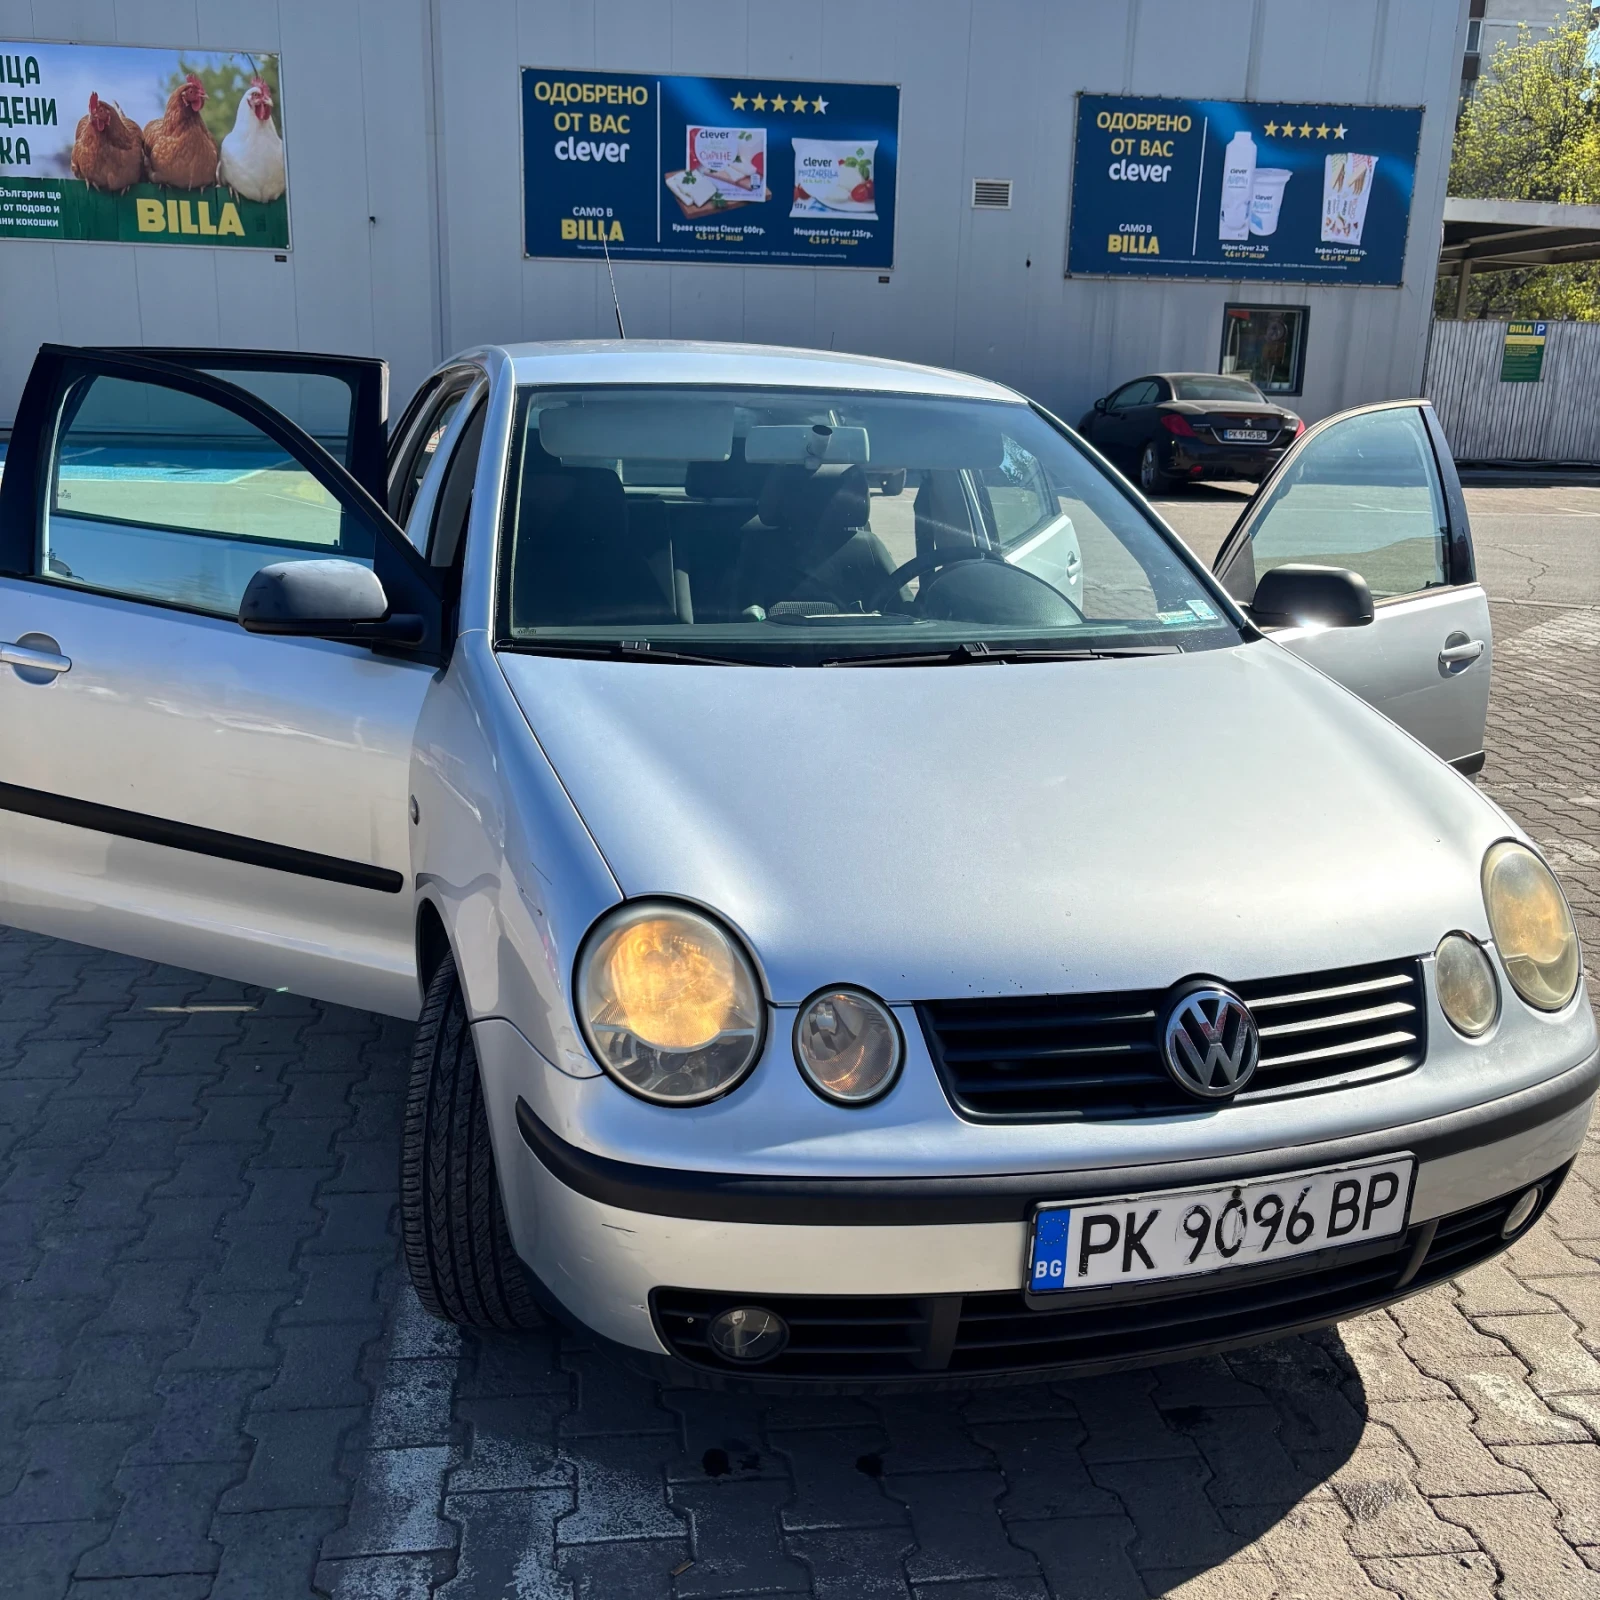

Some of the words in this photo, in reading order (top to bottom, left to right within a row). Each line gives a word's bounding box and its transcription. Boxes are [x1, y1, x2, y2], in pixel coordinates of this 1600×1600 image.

[534, 81, 648, 106] ОДОБРЕНО
[553, 112, 584, 132] ОТ
[589, 114, 631, 134] ВАС
[1096, 111, 1192, 133] ОДОБРЕНО
[700, 130, 729, 139] clever
[554, 136, 630, 163] clever
[1110, 138, 1136, 155] ОТ
[1140, 139, 1174, 157] ВАС
[803, 157, 832, 167] clever
[1108, 159, 1172, 182] clever
[47, 192, 61, 201] ще
[16, 204, 52, 214] подово
[53, 206, 60, 214] и
[136, 199, 246, 236] BILLA
[572, 206, 604, 217] САМО
[606, 208, 613, 217] В
[16, 218, 59, 227] кокошки
[561, 219, 624, 242] BILLA
[672, 223, 693, 233] Краве
[694, 225, 719, 233] сирене
[720, 224, 742, 233] Clever
[743, 226, 766, 236] 600гр.
[1119, 223, 1145, 233] САМО
[1146, 224, 1152, 233] В
[829, 228, 851, 237] Clever
[1107, 234, 1160, 254] BILLA
[1508, 324, 1532, 333] BILLA
[1536, 324, 1545, 335] P
[1182, 1184, 1315, 1266] 9096
[1034, 1259, 1063, 1278] BG
